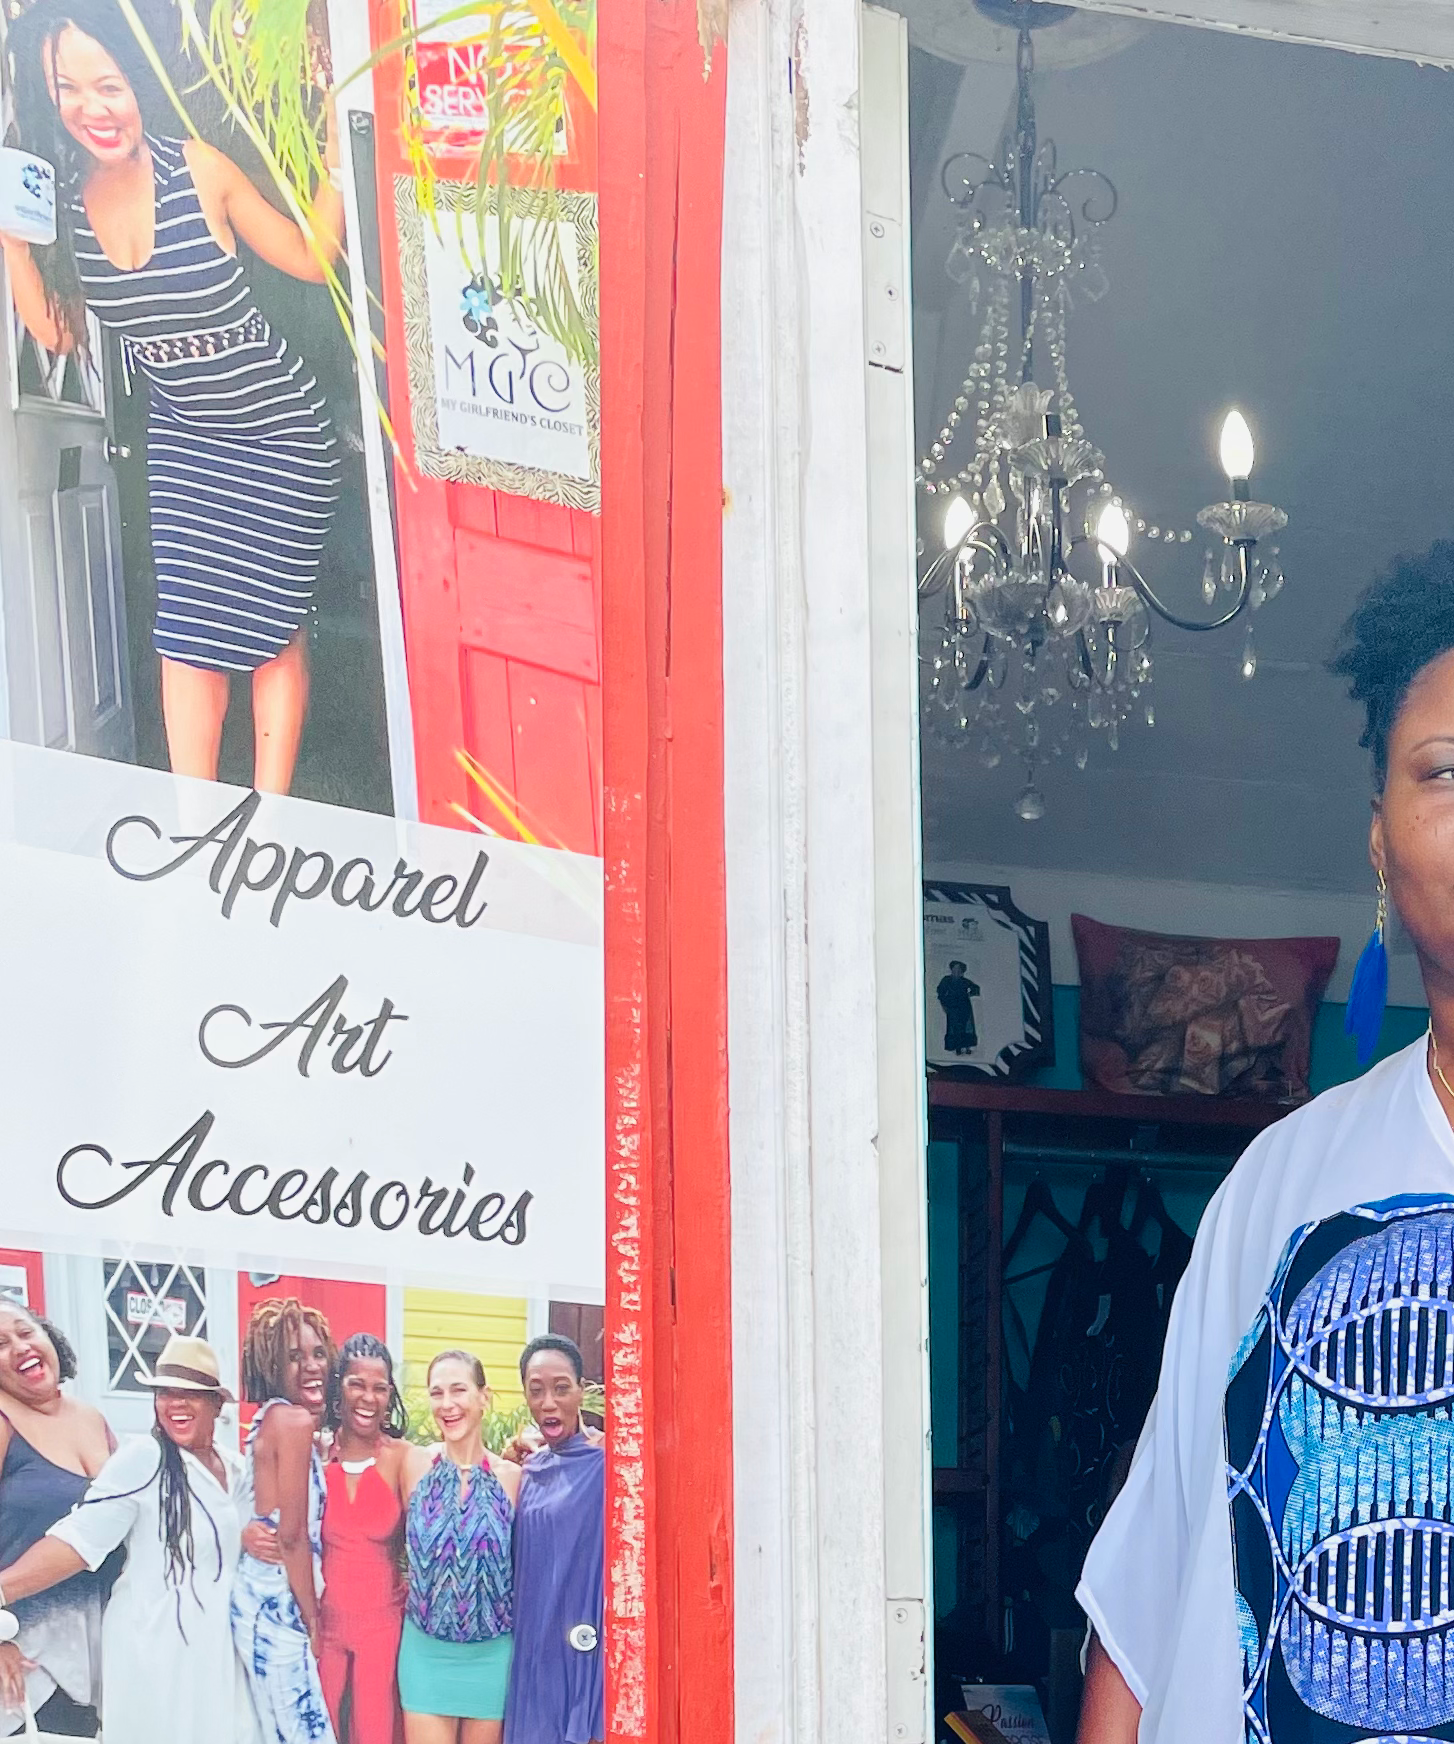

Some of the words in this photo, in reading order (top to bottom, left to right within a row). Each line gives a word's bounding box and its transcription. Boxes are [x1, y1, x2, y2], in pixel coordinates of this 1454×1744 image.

[440, 397, 457, 412] MY
[459, 400, 538, 427] GIRLFRIEND'S
[539, 416, 585, 437] CLOSET
[106, 789, 490, 928] Apparel
[199, 974, 409, 1078] Art
[57, 1109, 534, 1246] Accessories
